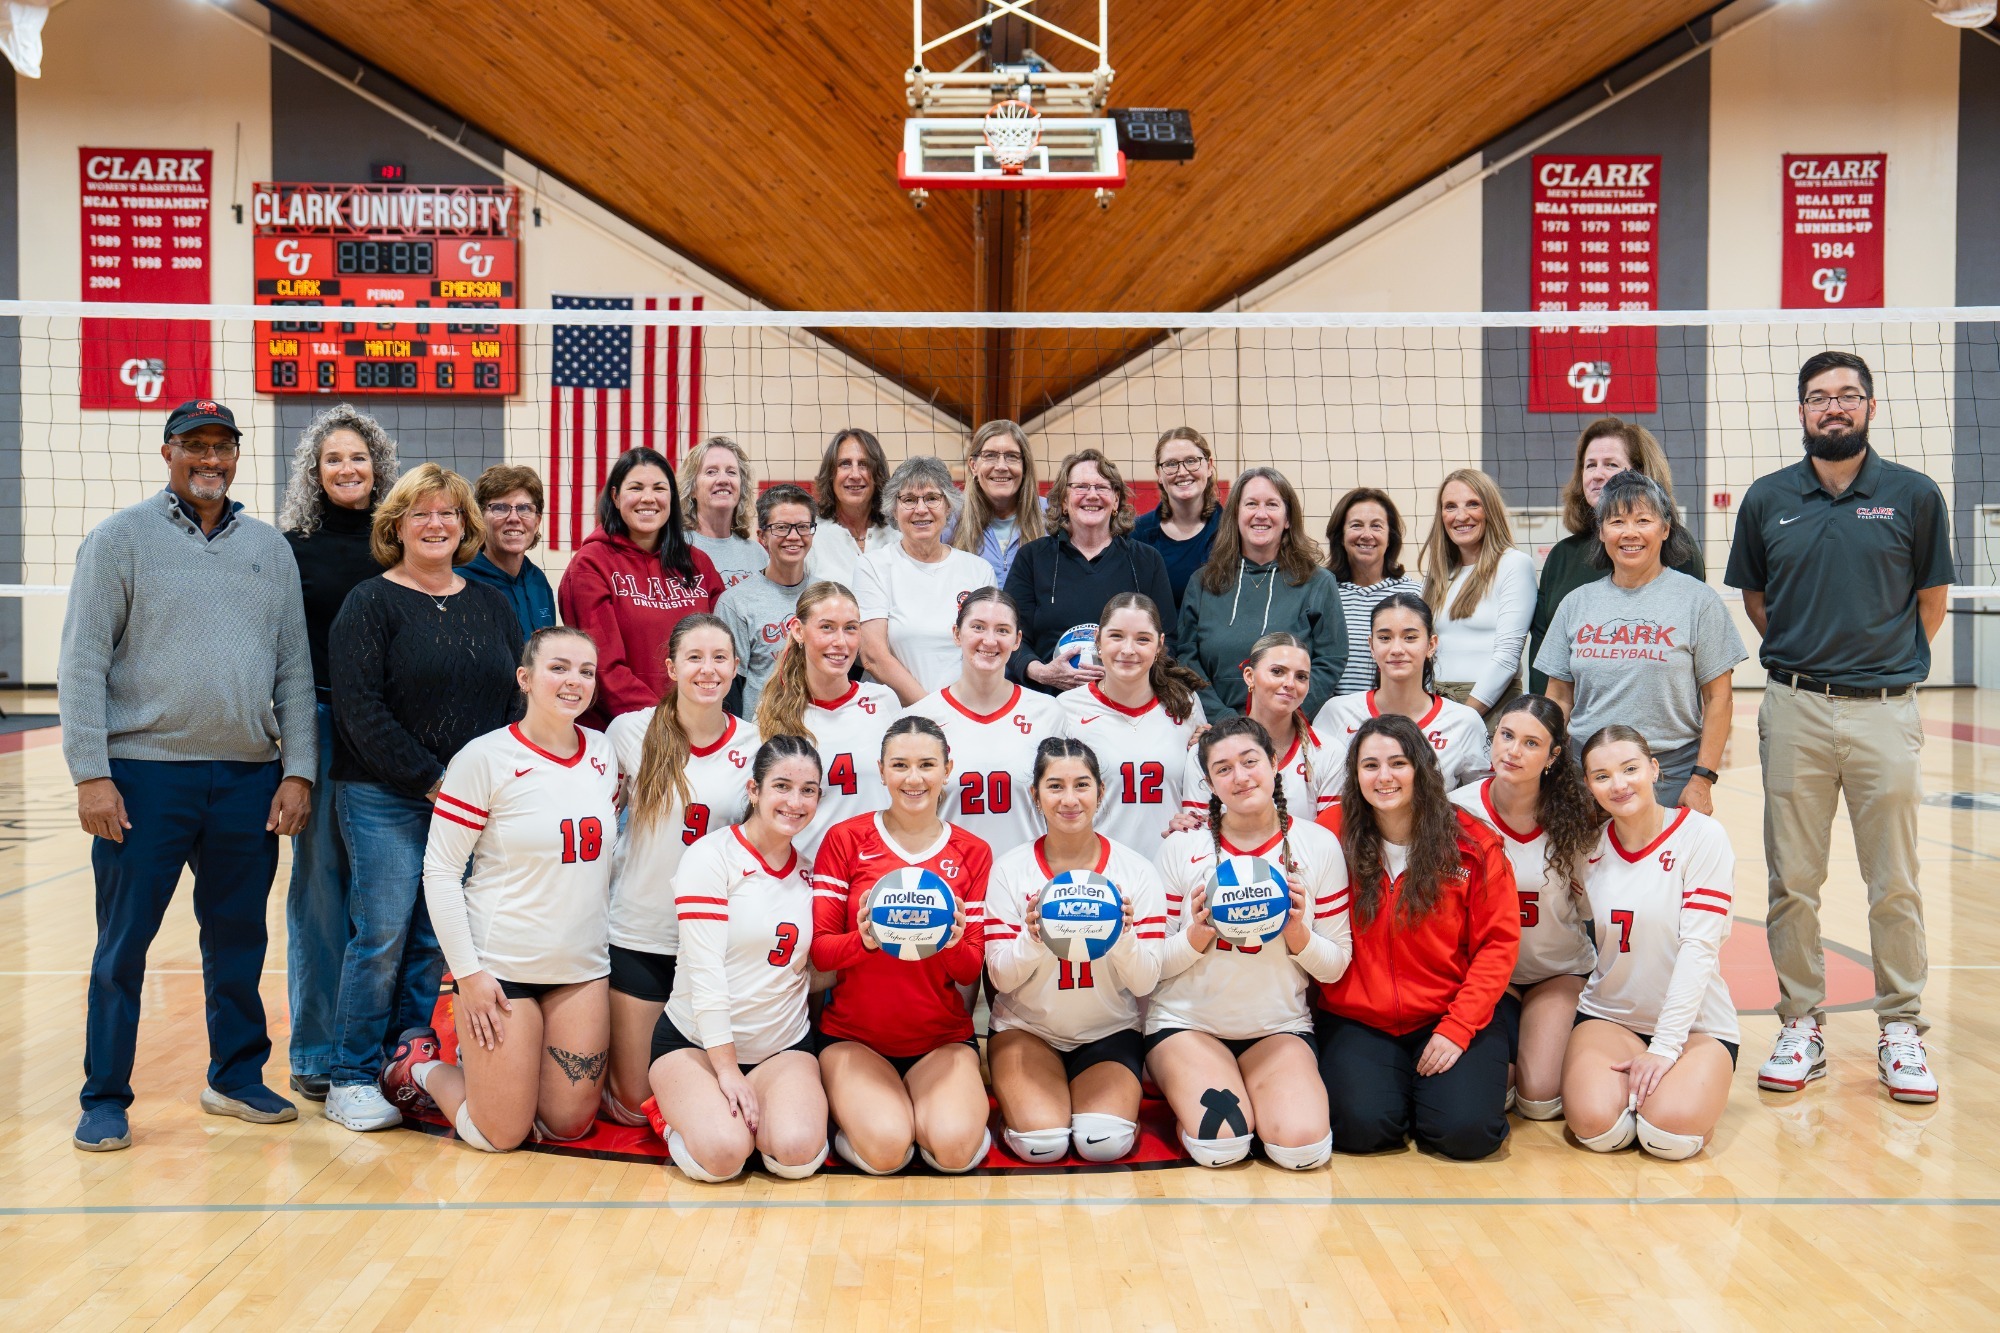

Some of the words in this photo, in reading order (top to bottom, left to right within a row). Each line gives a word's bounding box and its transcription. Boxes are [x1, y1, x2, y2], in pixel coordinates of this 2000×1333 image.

[87, 156, 204, 181] CLARK
[1540, 163, 1654, 187] CLARK
[1789, 160, 1881, 180] CLARK
[87, 182, 137, 192] WOMEN'S
[139, 183, 205, 193] BASKETBALL
[1822, 179, 1875, 187] BASKETBALL
[1546, 189, 1578, 198] MEN'S
[1580, 189, 1645, 198] BASKETBALL
[1796, 194, 1830, 206] NCAA
[1832, 194, 1856, 206] DIV.
[1858, 194, 1874, 205] III
[83, 195, 119, 208] NCAA
[121, 196, 209, 210] TOURNAMENT
[253, 192, 344, 226] CLARK
[352, 193, 513, 229] UNIVERSITY
[1535, 201, 1568, 214] NCAA
[1570, 202, 1657, 215] TOURNAMENT
[1798, 208, 1835, 220] FINAL
[1837, 208, 1870, 219] FOUR
[1541, 220, 1570, 233] 1978
[1581, 220, 1610, 233] 1979
[1621, 220, 1650, 233] 1980
[1795, 222, 1873, 234] RUNNERS-UP
[131, 236, 162, 249] 1992
[1541, 240, 1569, 253] 1981
[1580, 241, 1609, 253] 1982
[1812, 242, 1855, 259] 1984
[90, 255, 121, 268] 1997
[171, 257, 202, 270] 2000
[274, 239, 312, 276] CU
[458, 241, 494, 278] CU
[1541, 260, 1569, 273] 1984
[89, 275, 121, 289] 2004
[277, 279, 321, 296] CLARK
[440, 281, 501, 298] EMERSON
[367, 289, 404, 301] PERIOD
[269, 339, 298, 356] WON
[365, 341, 411, 357] MATCH
[471, 341, 500, 358] WON
[1856, 506, 1895, 516] CLARK
[612, 571, 708, 602] CLARK
[633, 598, 695, 610] UNIVERSITY
[1577, 623, 1677, 647] CLARK
[1576, 647, 1668, 662] VOLLEYBALL
[857, 696, 876, 715] CU
[1013, 715, 1032, 734] CU
[1428, 730, 1448, 750] CU
[590, 757, 606, 775] CU
[728, 750, 747, 769] CU
[828, 752, 857, 795] 4
[1120, 761, 1164, 804] 12
[960, 771, 1012, 815] 20
[681, 803, 710, 846] 9
[560, 816, 602, 864] 18
[940, 859, 959, 878] CU
[1659, 850, 1676, 872] CU
[883, 892, 935, 906] molten
[1054, 885, 1105, 899] molten
[1222, 887, 1272, 903] molten
[887, 908, 930, 924] NCAA
[1058, 902, 1100, 916] NCAA
[1227, 902, 1269, 920] NCAA
[1611, 909, 1634, 953] 7
[768, 922, 799, 967] 3
[1058, 957, 1094, 990] 11
